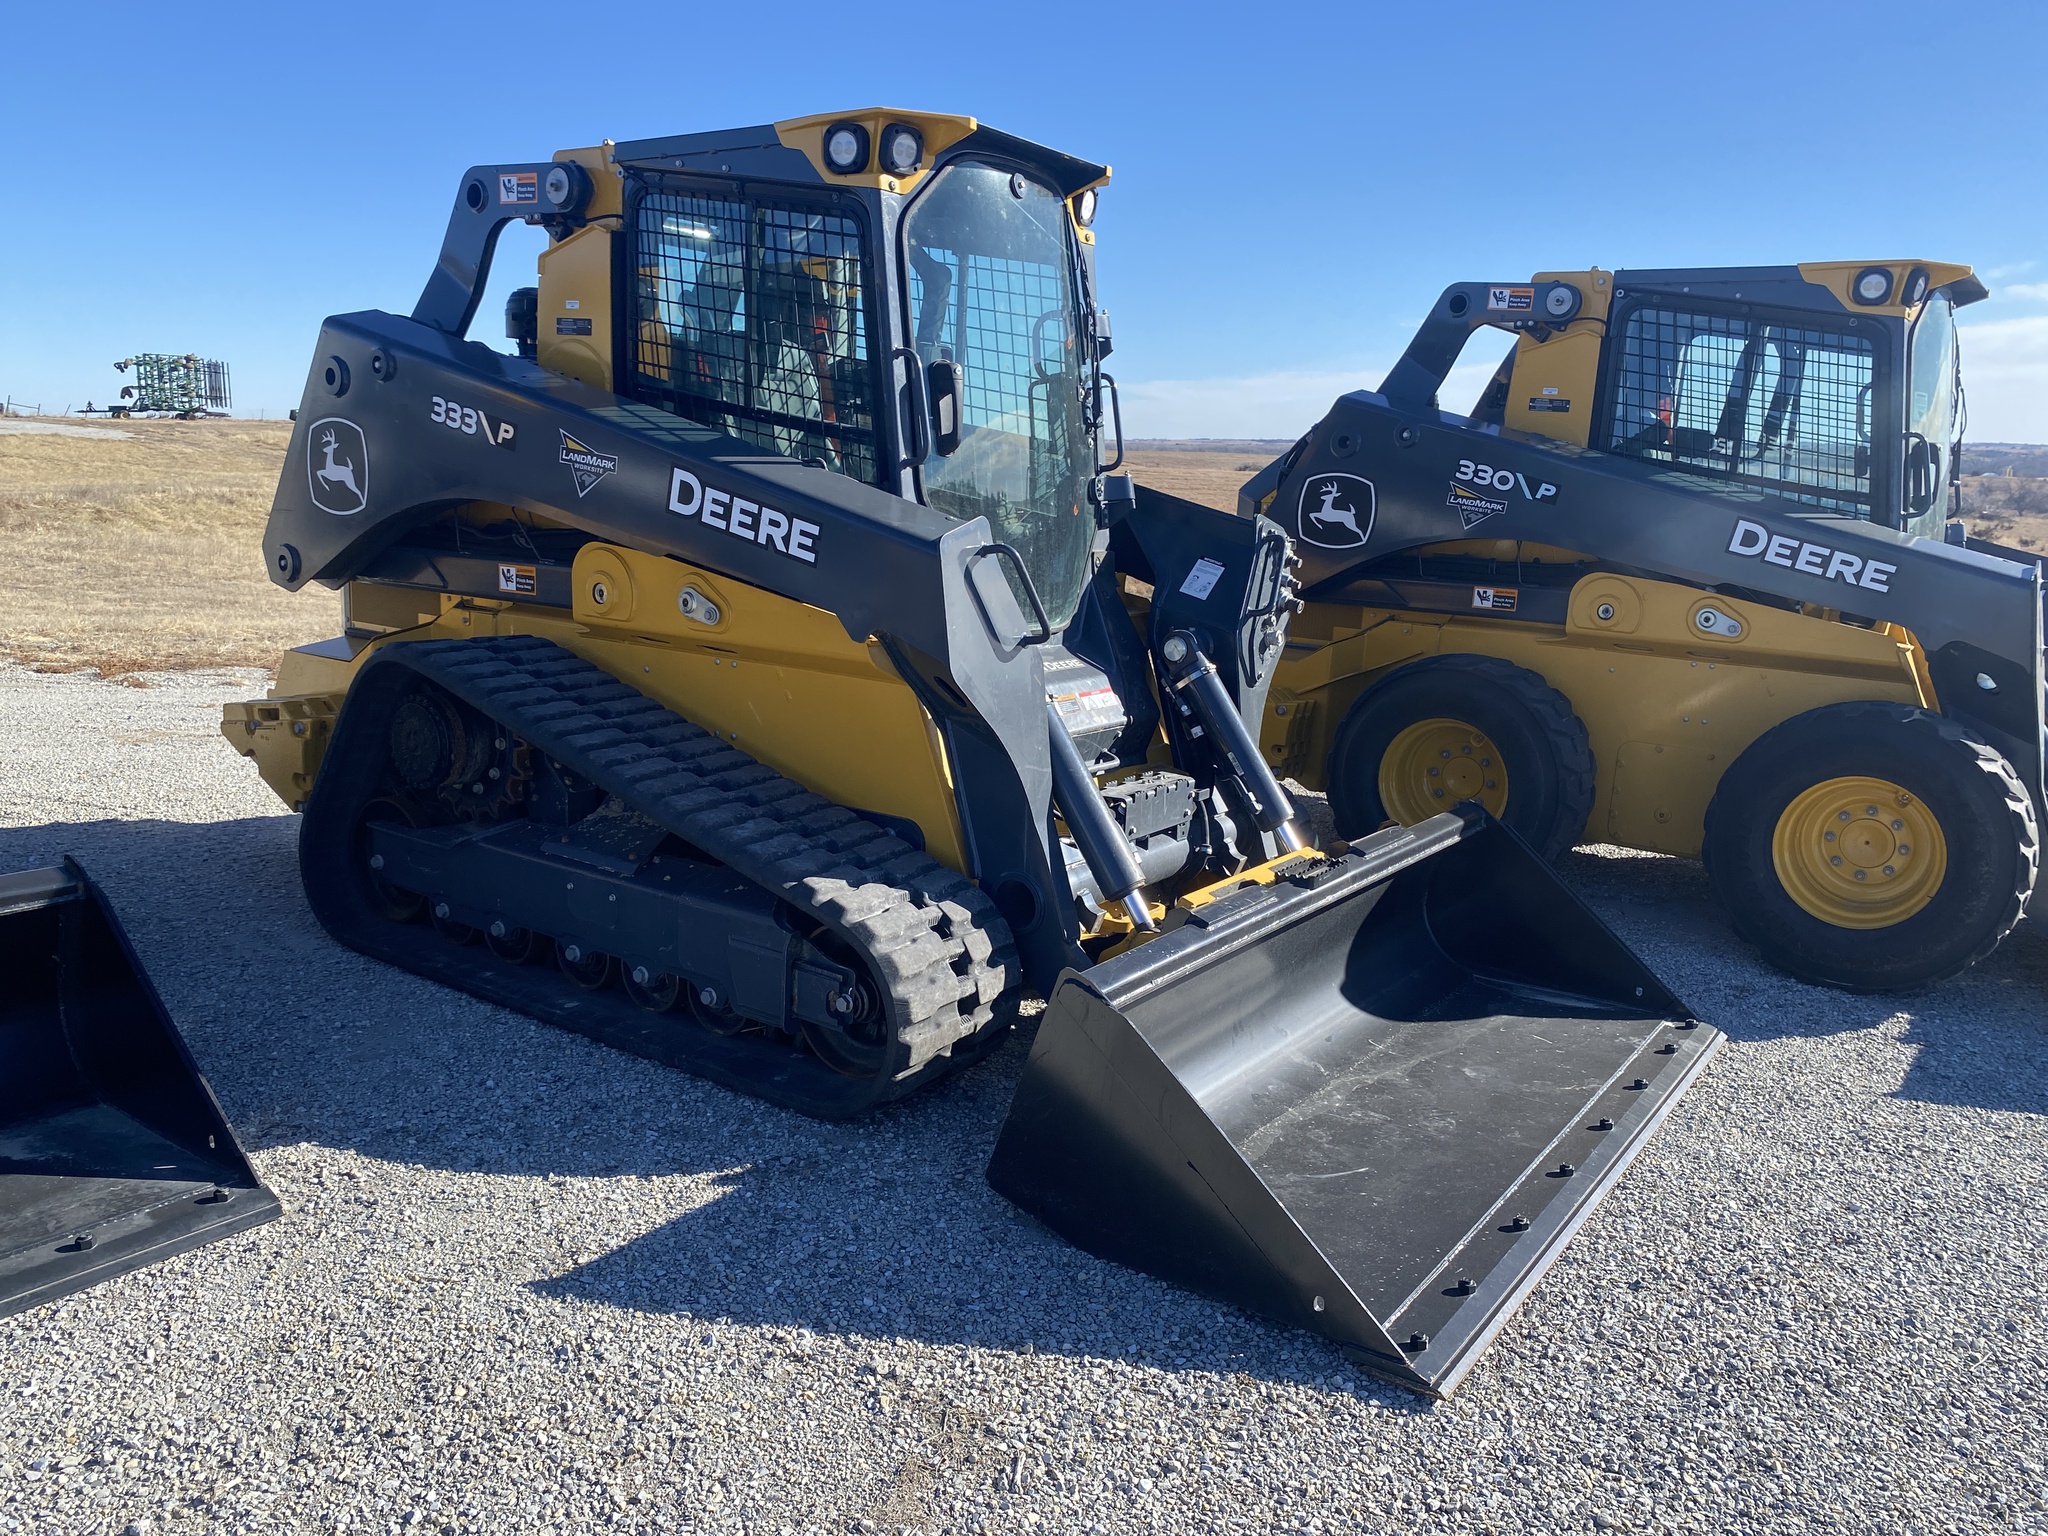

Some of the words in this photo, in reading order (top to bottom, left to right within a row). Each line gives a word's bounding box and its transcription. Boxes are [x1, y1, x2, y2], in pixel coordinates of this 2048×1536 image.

[574, 463, 604, 474] WORKSITE
[668, 467, 820, 563] DEERE
[1462, 505, 1492, 514] WORKSITE
[1728, 519, 1897, 593] DEERE
[1043, 659, 1086, 670] DEERE
